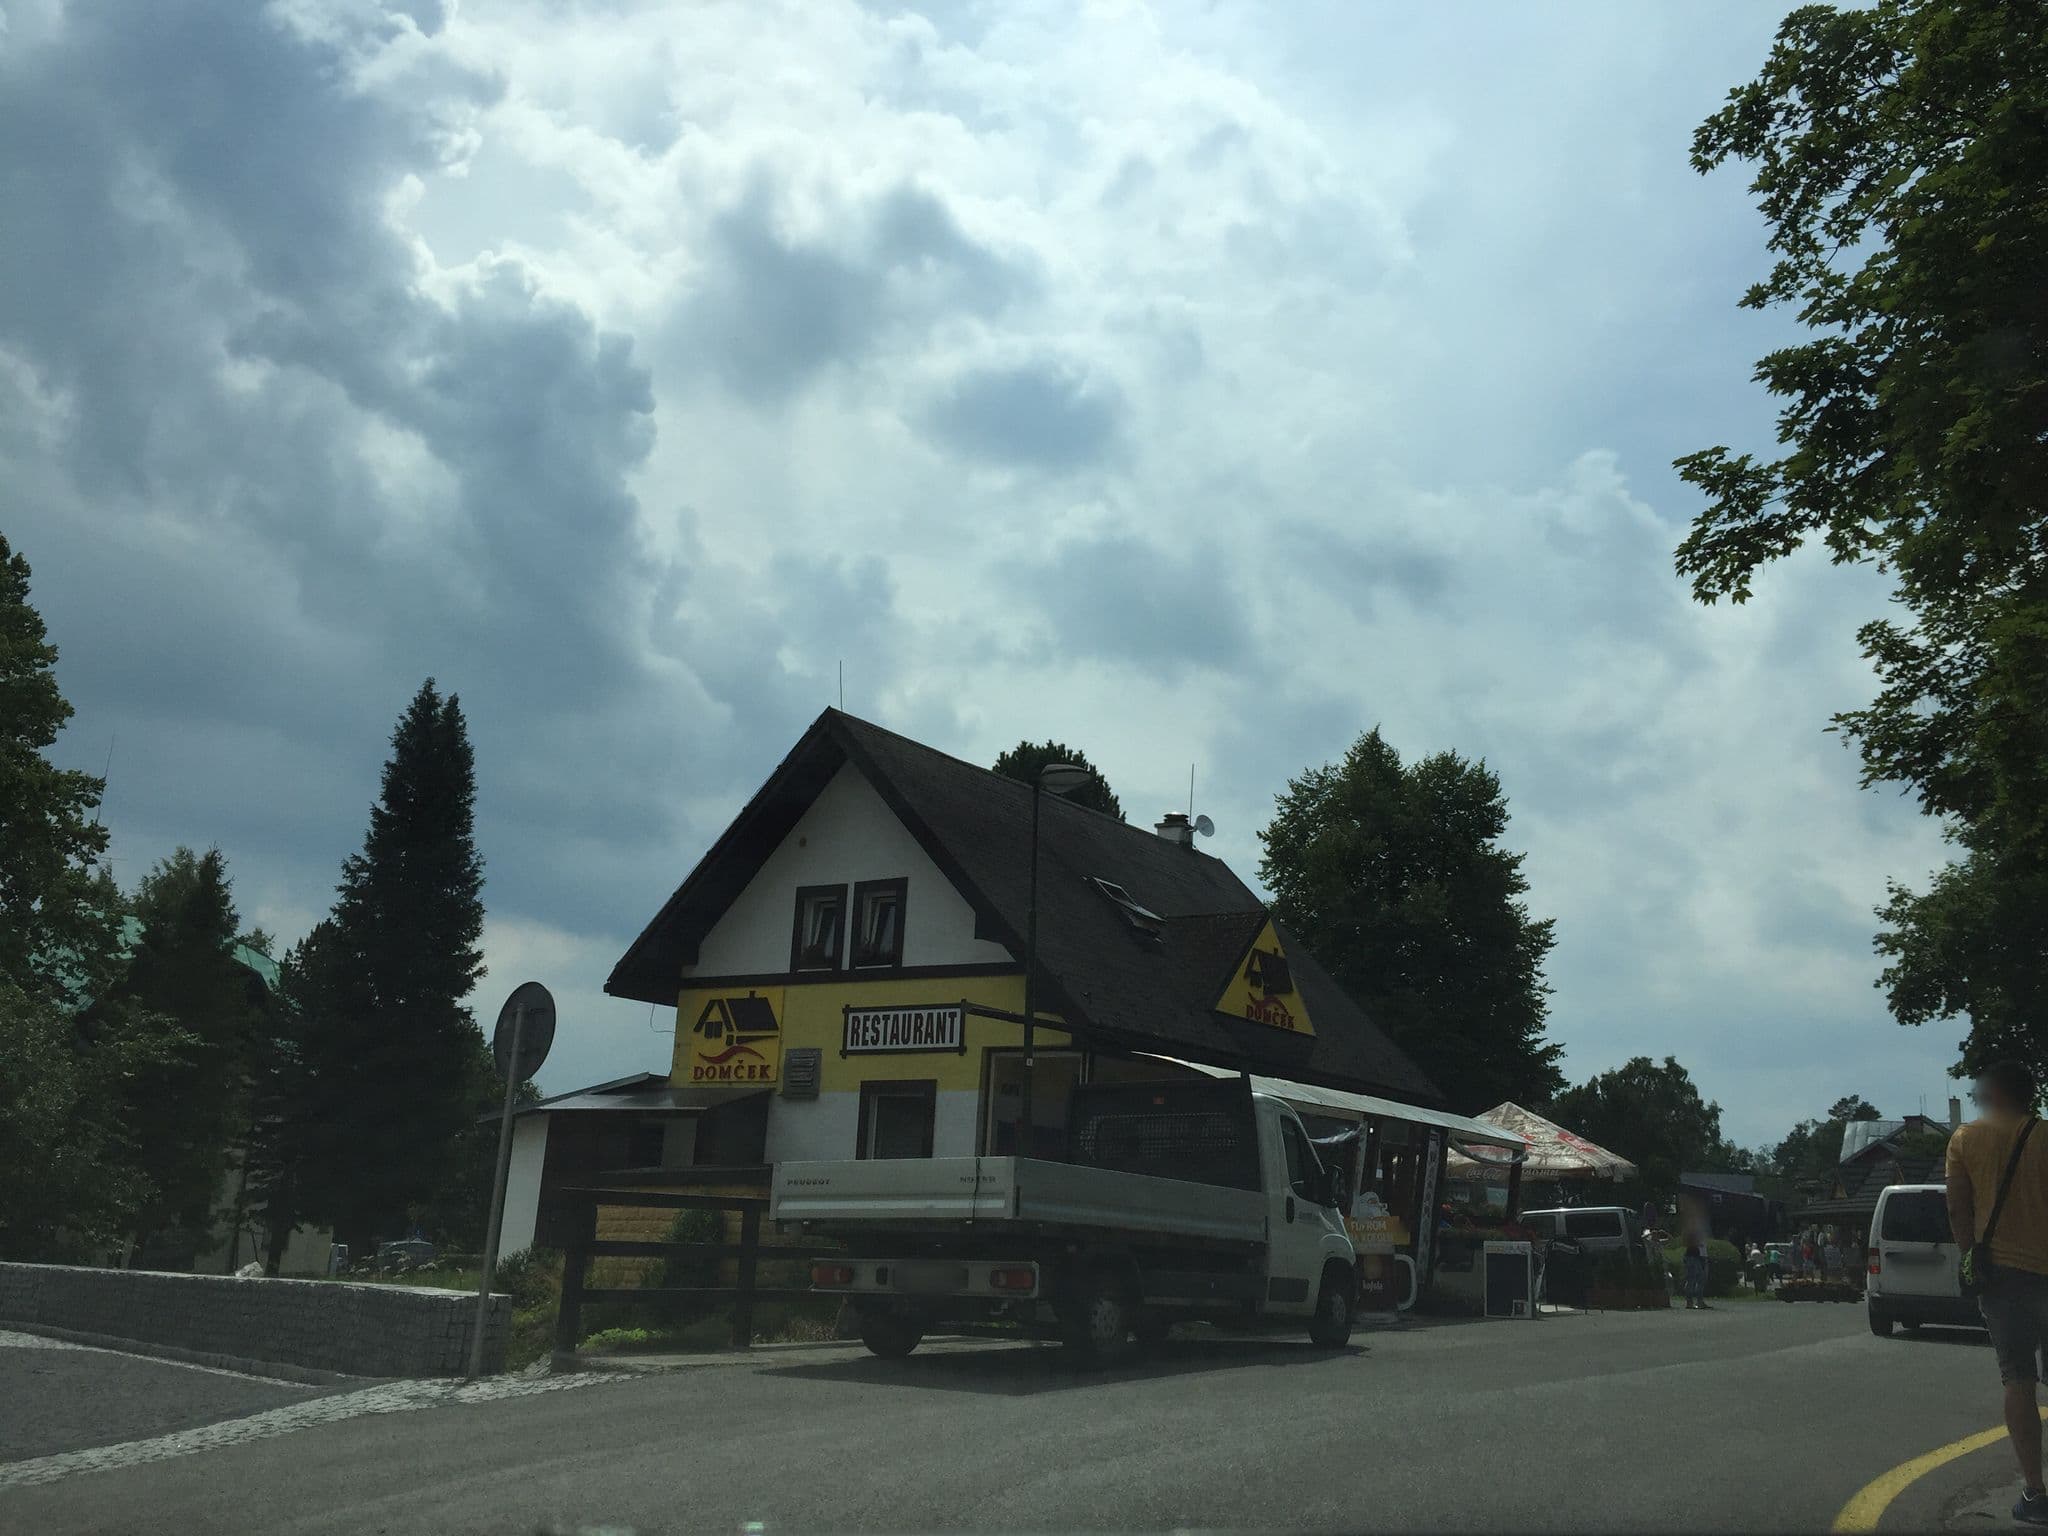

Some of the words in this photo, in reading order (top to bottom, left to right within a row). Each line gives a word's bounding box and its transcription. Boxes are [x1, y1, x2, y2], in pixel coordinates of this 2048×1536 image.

[850, 1011, 958, 1047] RESTAURANT
[1247, 1005, 1295, 1029] DOMČEK
[693, 1059, 771, 1081] DOMČEK
